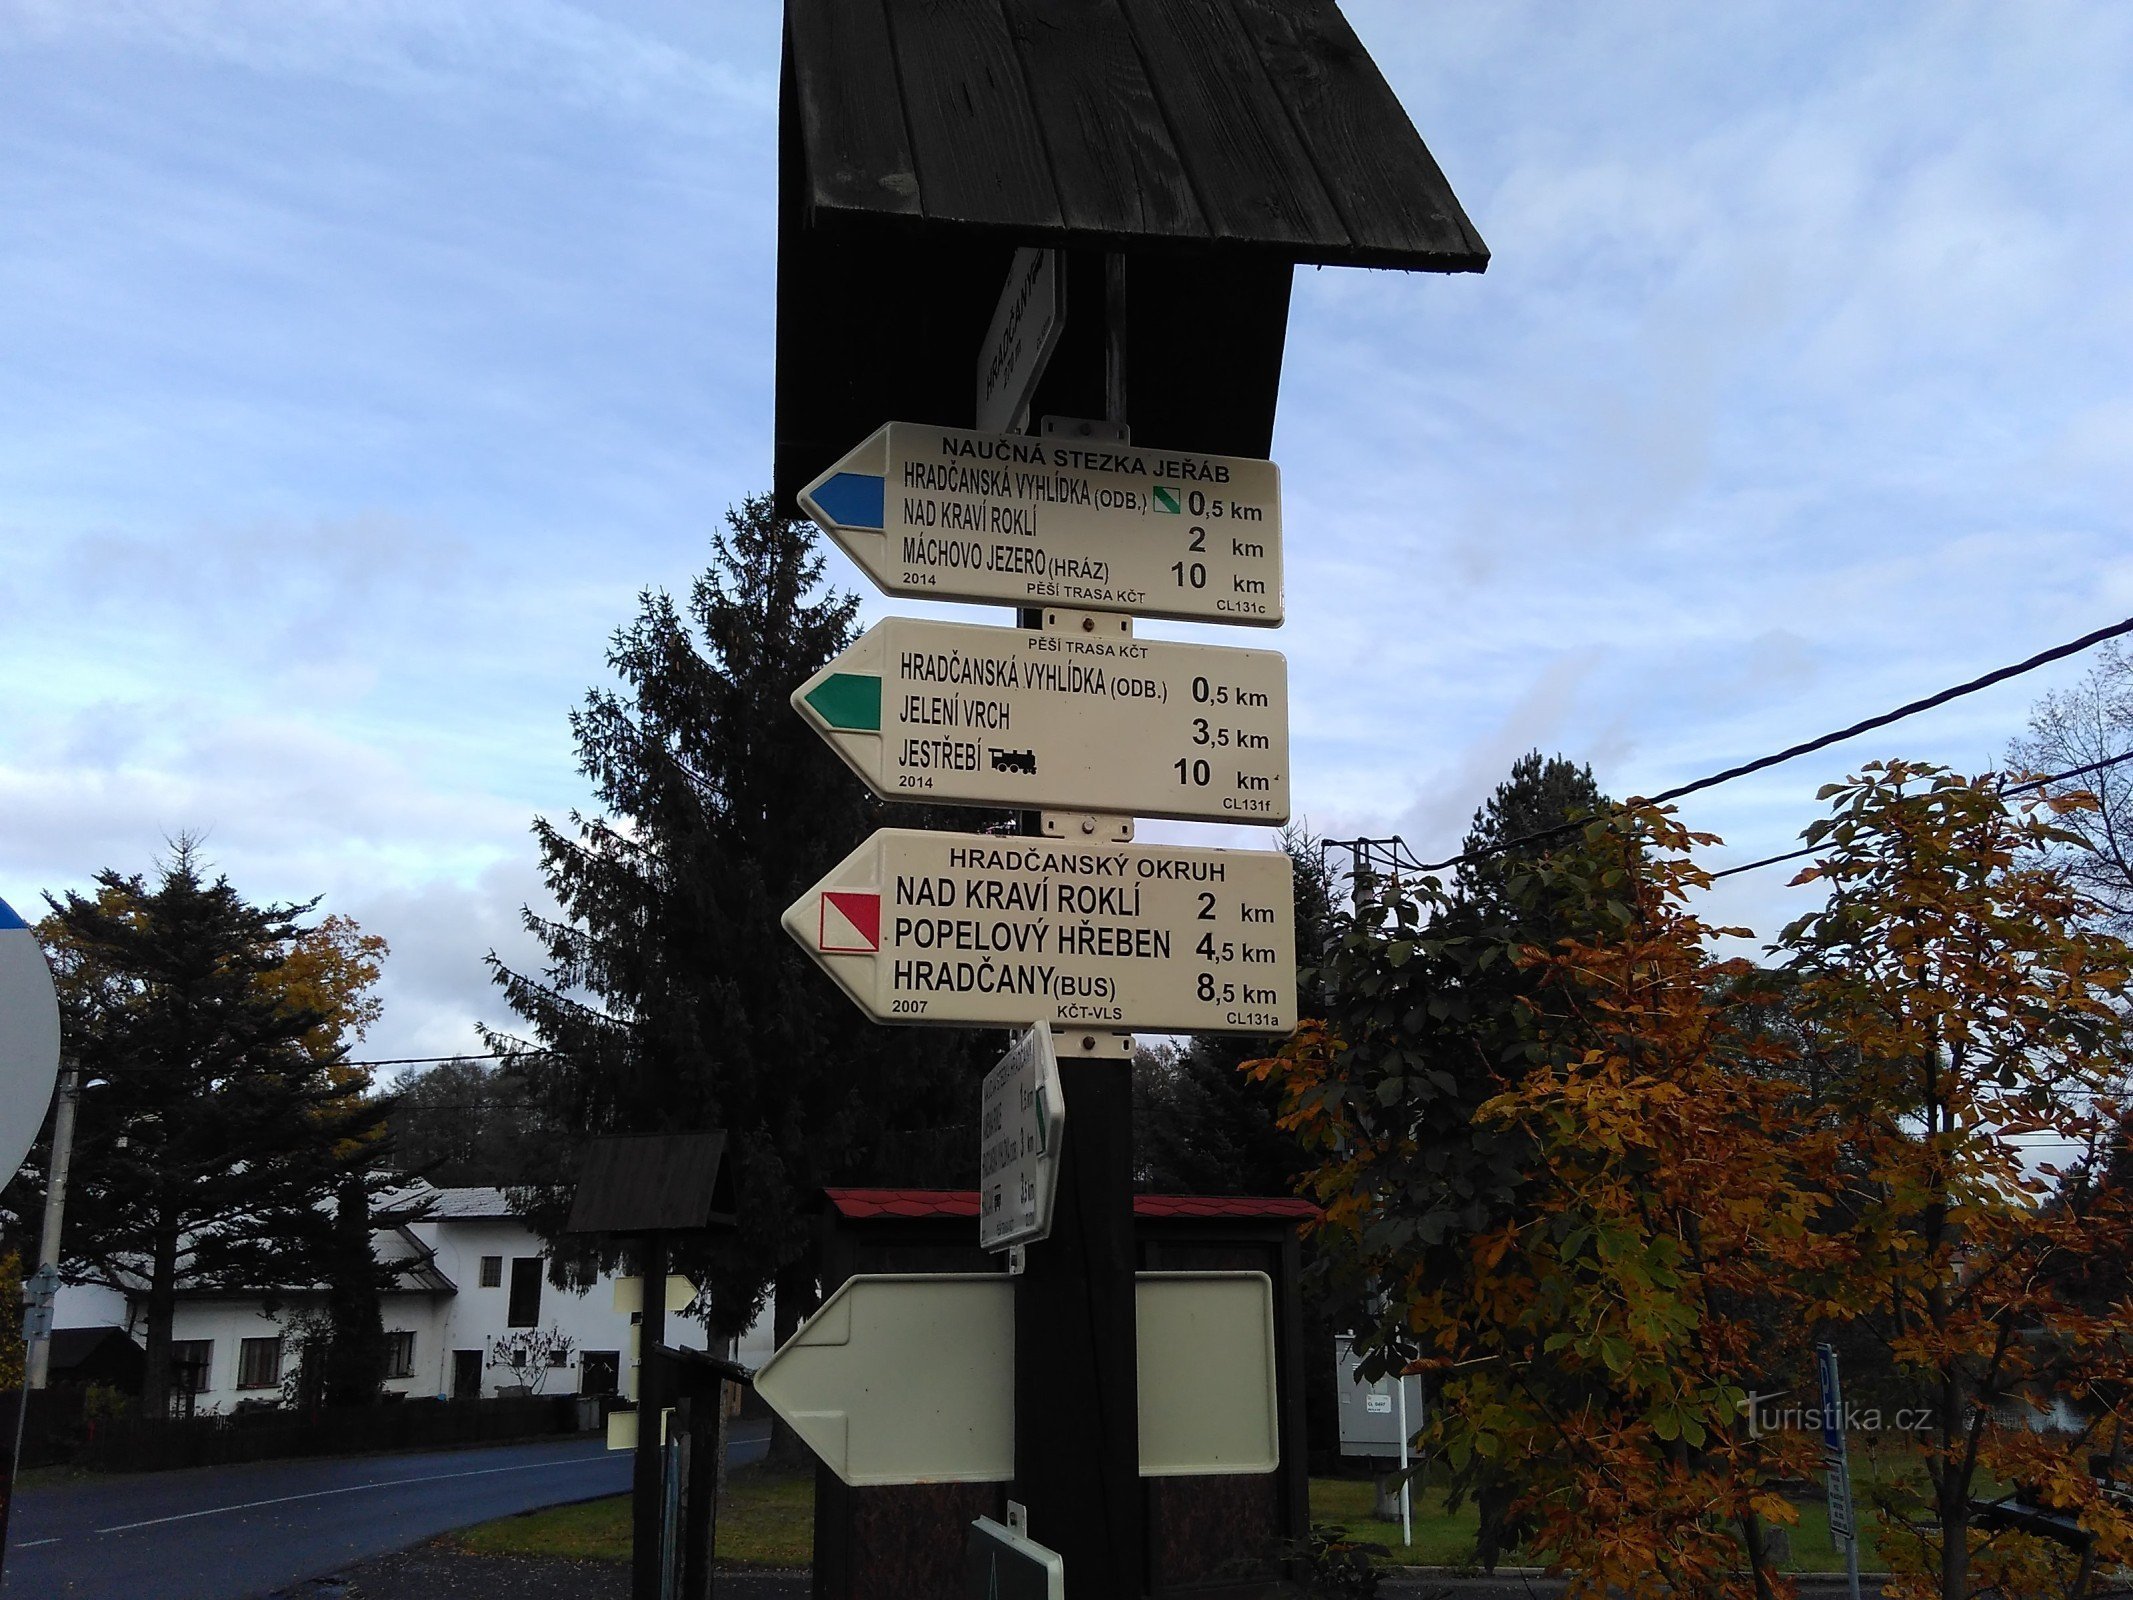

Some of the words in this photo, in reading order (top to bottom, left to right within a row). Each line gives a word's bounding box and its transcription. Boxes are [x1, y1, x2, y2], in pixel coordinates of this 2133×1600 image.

[943, 437, 1047, 466] NAUČNÁ
[1053, 449, 1144, 476] STEZKA
[1153, 458, 1230, 484] JEŘÁB
[905, 461, 1012, 498] HRADČANSKÁ
[1015, 472, 1091, 506] VYHLÍDKA
[1094, 488, 1147, 516] (ODB.)
[1188, 490, 1224, 520] 0,5
[1231, 501, 1262, 522] km
[904, 498, 936, 527] NAD
[941, 499, 987, 532] KRAVÍ
[991, 504, 1037, 537] ROKLÍ
[1189, 526, 1206, 553] 2
[1232, 538, 1264, 558] km
[903, 535, 982, 570] MÁCHOVO
[1171, 561, 1206, 589] 10
[1234, 574, 1265, 594] km
[903, 572, 936, 586] 2014
[1027, 581, 1060, 596] PĚŠÍ
[1064, 586, 1114, 601] TRASA
[1117, 589, 1146, 604] KČT
[1217, 599, 1266, 614] CL131c
[1029, 636, 1061, 652] PĚŠÍ
[1065, 641, 1116, 657] TRASA
[1119, 644, 1148, 659] KČT
[901, 651, 1018, 688] HRADČANSKÁ
[1024, 662, 1106, 696] VYHLÍDKA
[1111, 677, 1168, 704] (ODB.)
[1192, 677, 1228, 707] 0,5
[1236, 687, 1268, 707] km
[900, 692, 959, 726] JELENÍ
[963, 700, 1010, 730] VRCH
[1192, 718, 1230, 748] 3,5
[1237, 729, 1269, 750] km
[899, 736, 982, 772] JESTŘEBÍ
[1174, 758, 1210, 786] 10
[1237, 771, 1270, 791] km
[899, 775, 934, 789] 2014
[1223, 798, 1271, 812] CL131f
[950, 848, 1130, 877] HRADČANSKÝ
[1137, 859, 1225, 882] OKRUH
[897, 876, 956, 907] NAD
[966, 876, 1050, 912] KRAVÍ
[1058, 881, 1141, 917] ROKLÍ
[1197, 892, 1216, 920] 2
[1241, 903, 1274, 924] km
[895, 917, 1048, 953] POPELOVÝ
[1059, 920, 1170, 959] HŘEBEN
[1196, 932, 1234, 965] 4,5
[1242, 943, 1276, 964] km
[1197, 973, 1235, 1006] 8,5
[1243, 984, 1277, 1005] km
[892, 1000, 928, 1014] 2007
[1058, 1003, 1122, 1020] KČT-VLS
[1227, 1012, 1279, 1026] CL131a
